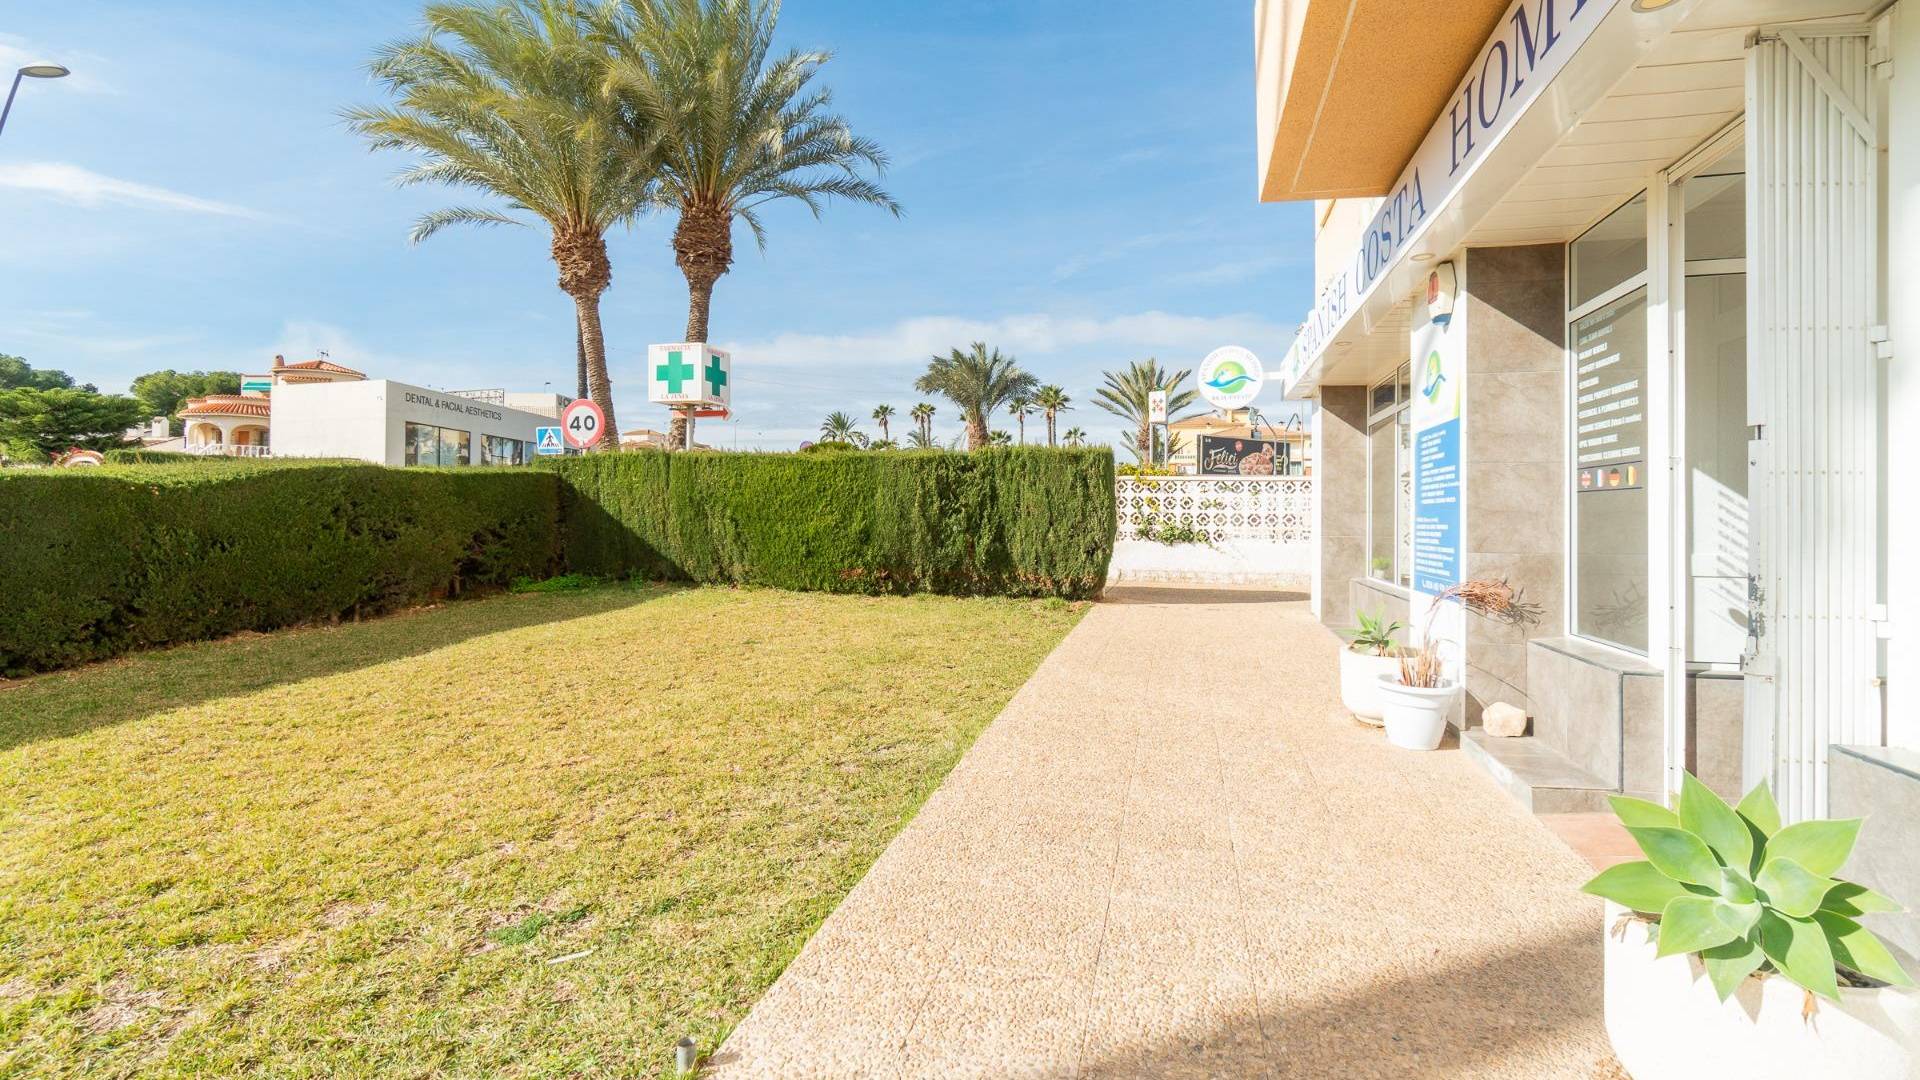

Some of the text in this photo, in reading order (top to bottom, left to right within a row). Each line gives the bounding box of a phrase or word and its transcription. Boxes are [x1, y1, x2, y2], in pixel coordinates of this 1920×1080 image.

[1356, 166, 1426, 295] COSTA
[1449, 0, 1587, 176] HOM
[405, 392, 502, 421] DENTAL & FACIAL AESTHETICS
[569, 415, 596, 432] 40
